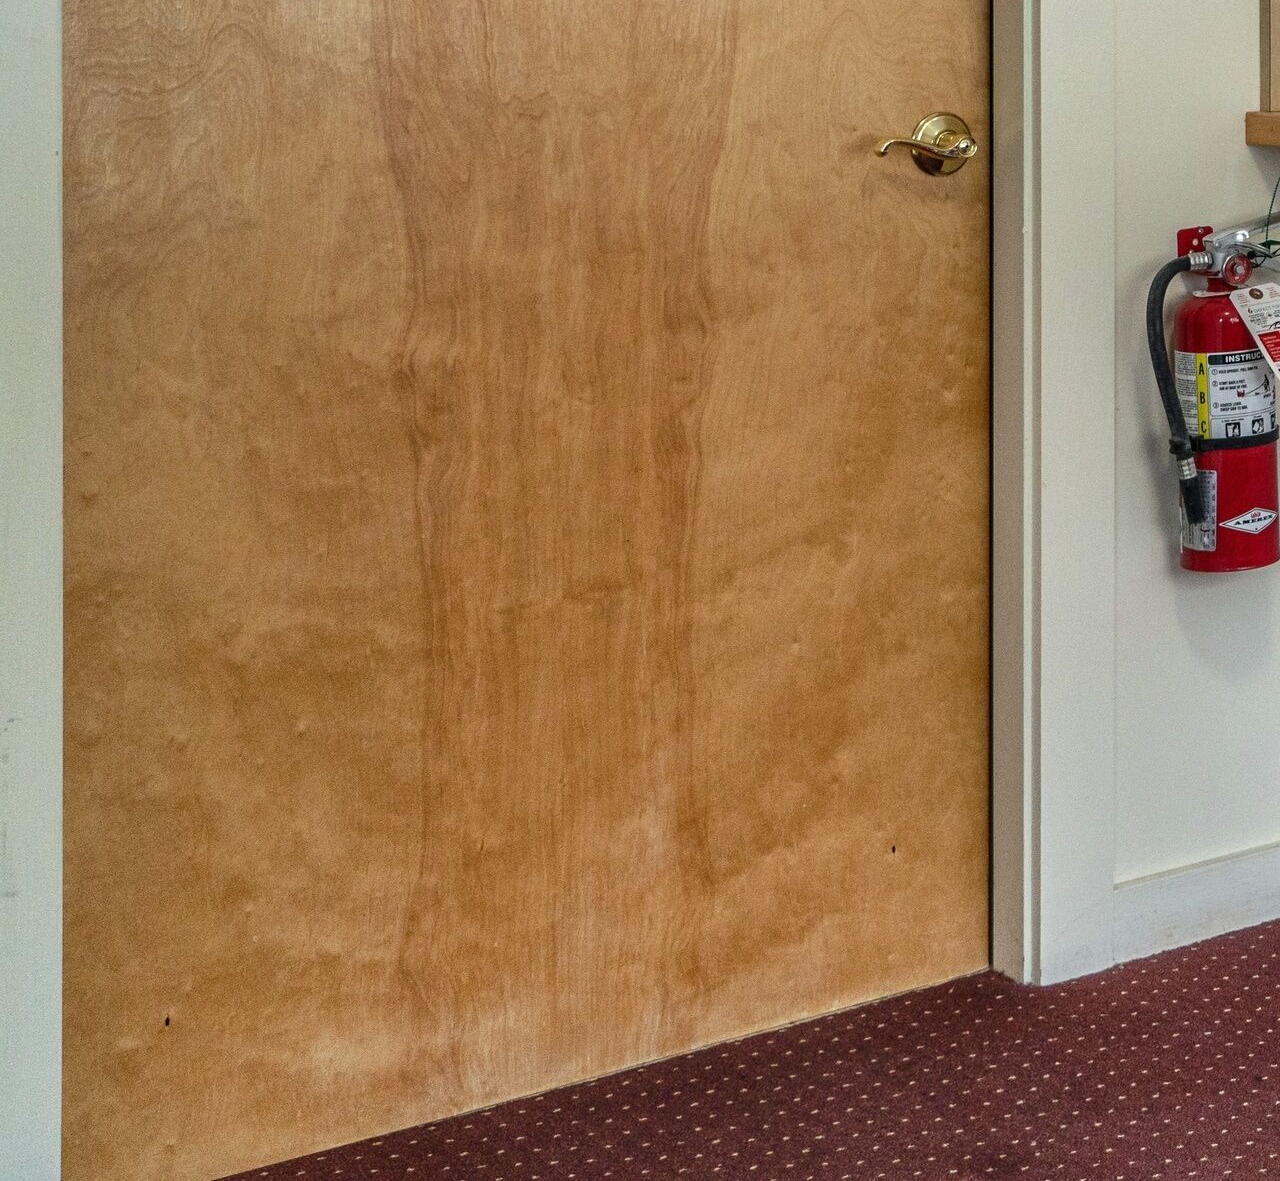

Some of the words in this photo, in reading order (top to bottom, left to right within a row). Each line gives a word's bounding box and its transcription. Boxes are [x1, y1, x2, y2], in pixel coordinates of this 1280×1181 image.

[1225, 351, 1264, 363] INSTRUC
[1199, 363, 1205, 375] A
[1200, 392, 1206, 404] B
[1201, 421, 1207, 433] C
[1234, 514, 1273, 525] AMEREX
